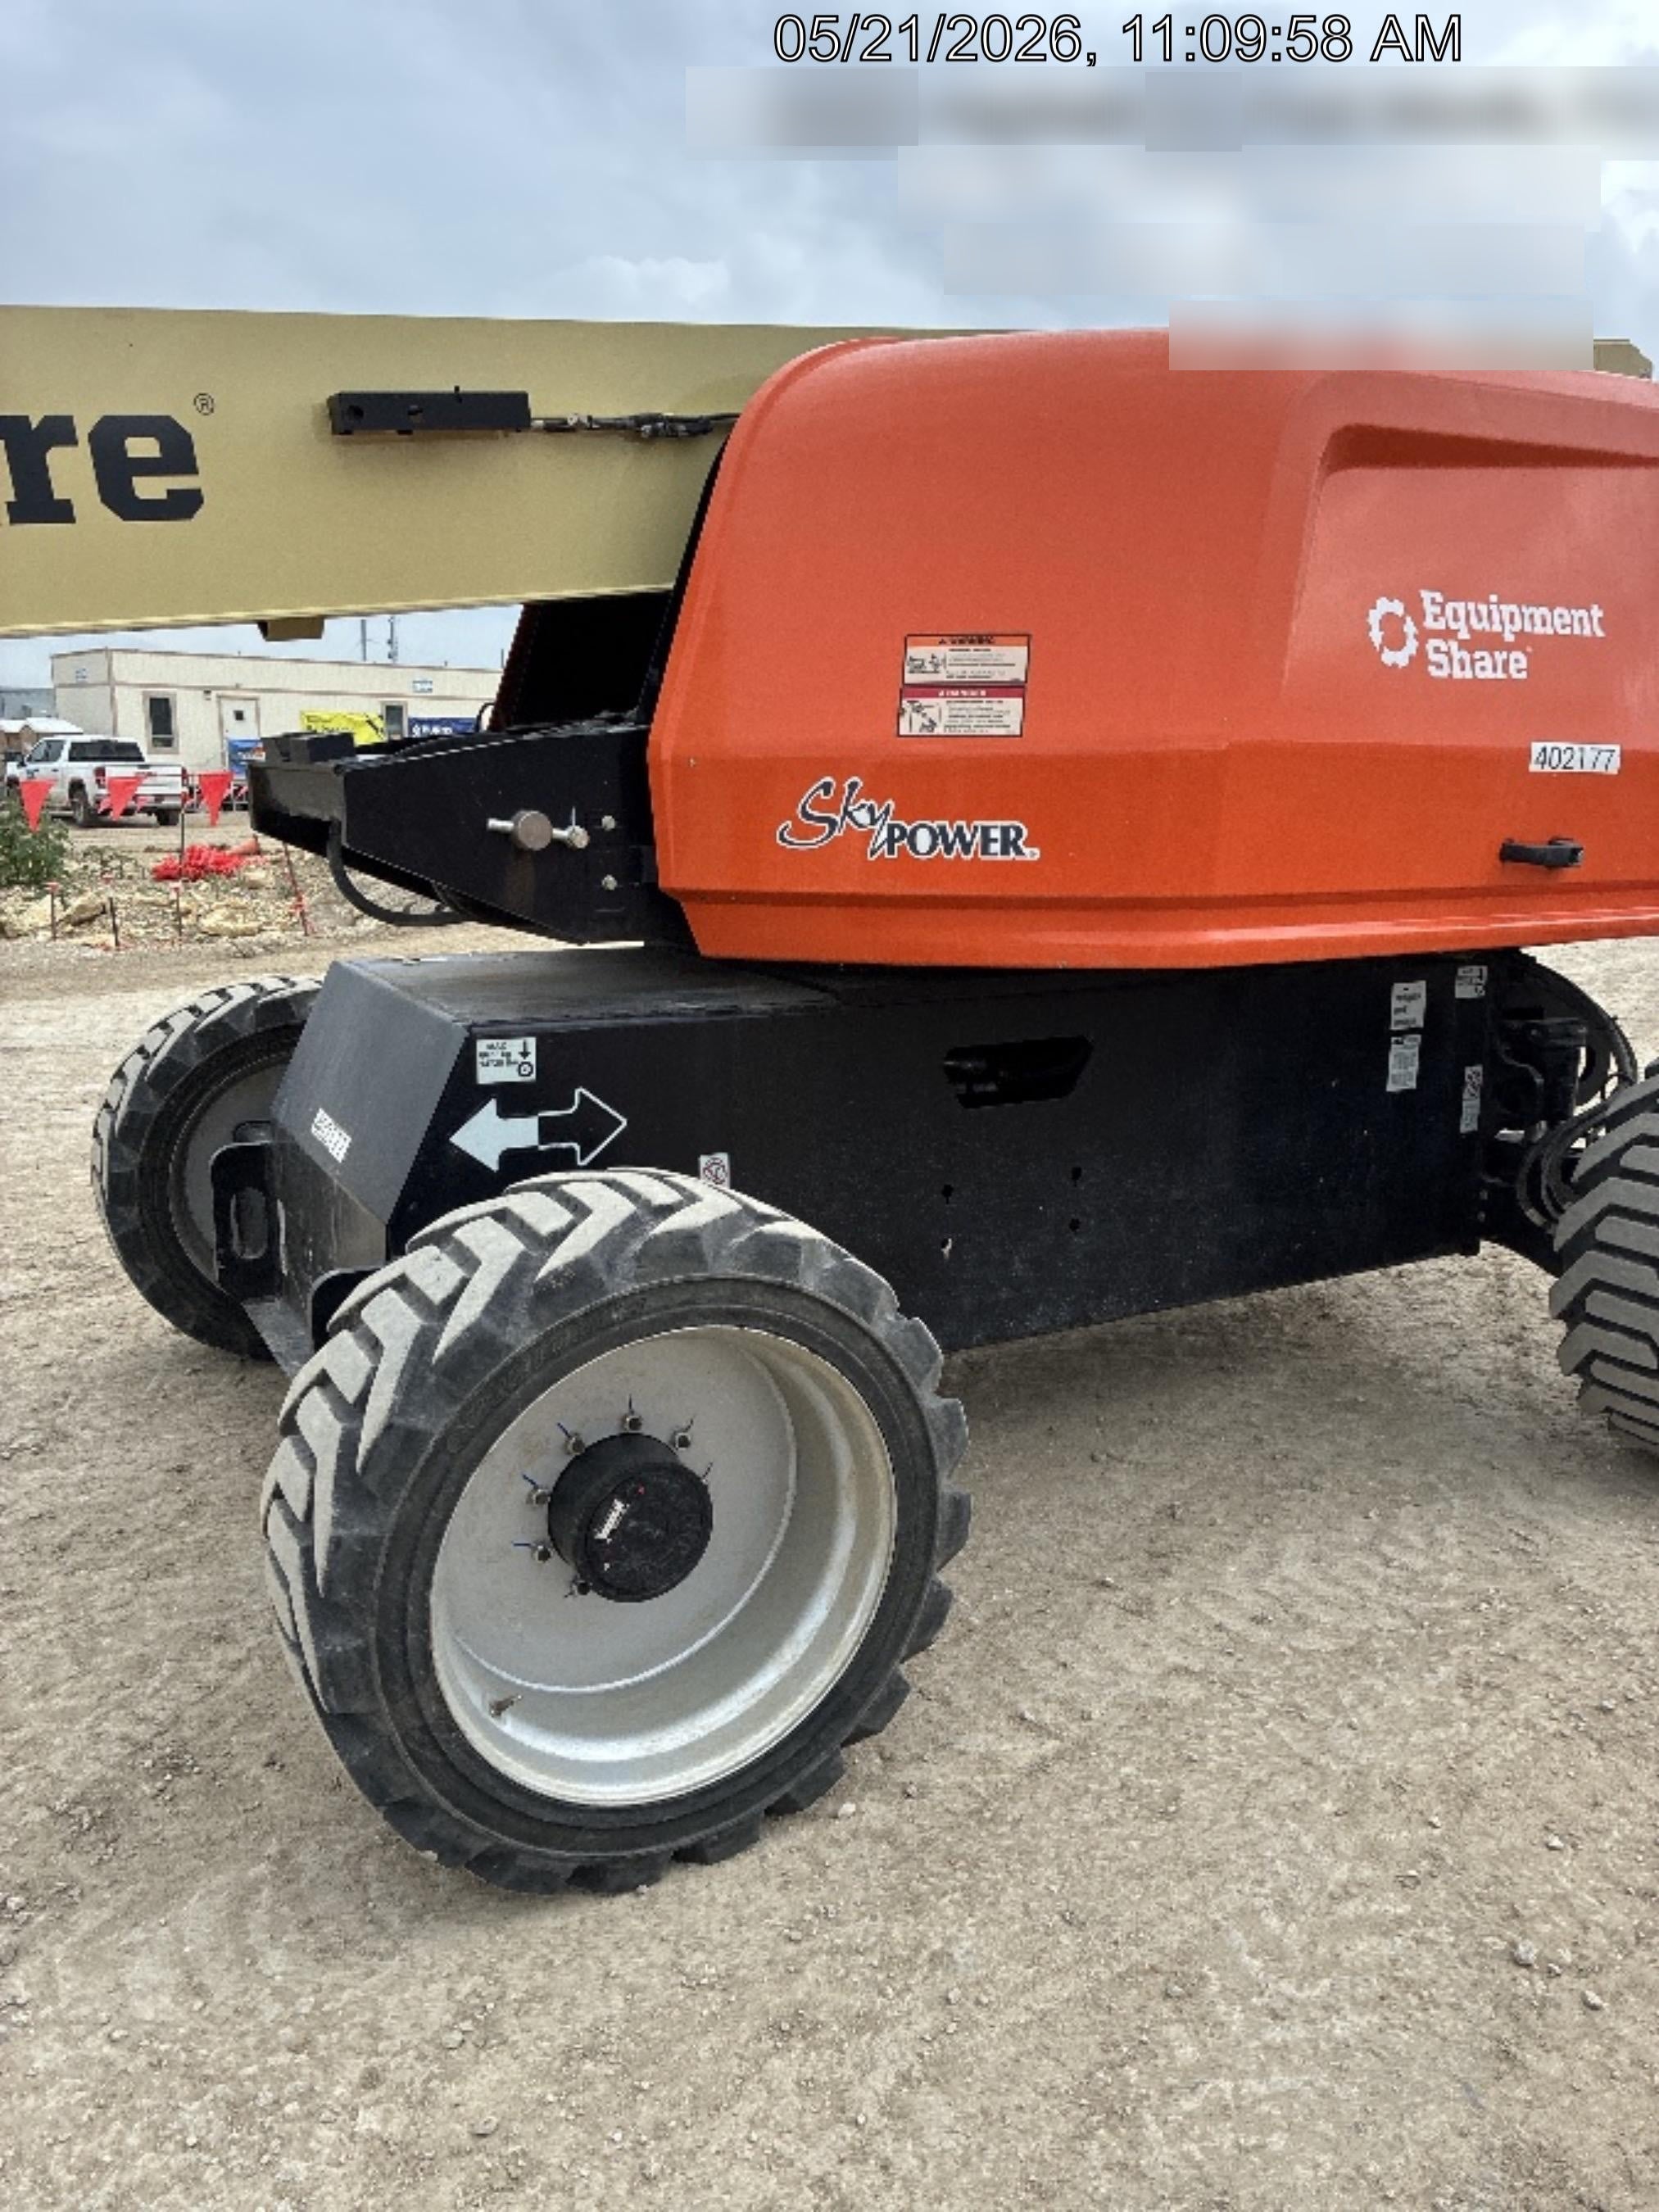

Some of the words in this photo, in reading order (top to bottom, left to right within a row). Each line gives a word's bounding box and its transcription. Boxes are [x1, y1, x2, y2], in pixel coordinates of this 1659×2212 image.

[1419, 589, 1606, 642] Equipment
[1426, 638, 1527, 679] Share
[1534, 746, 1616, 772] 402177
